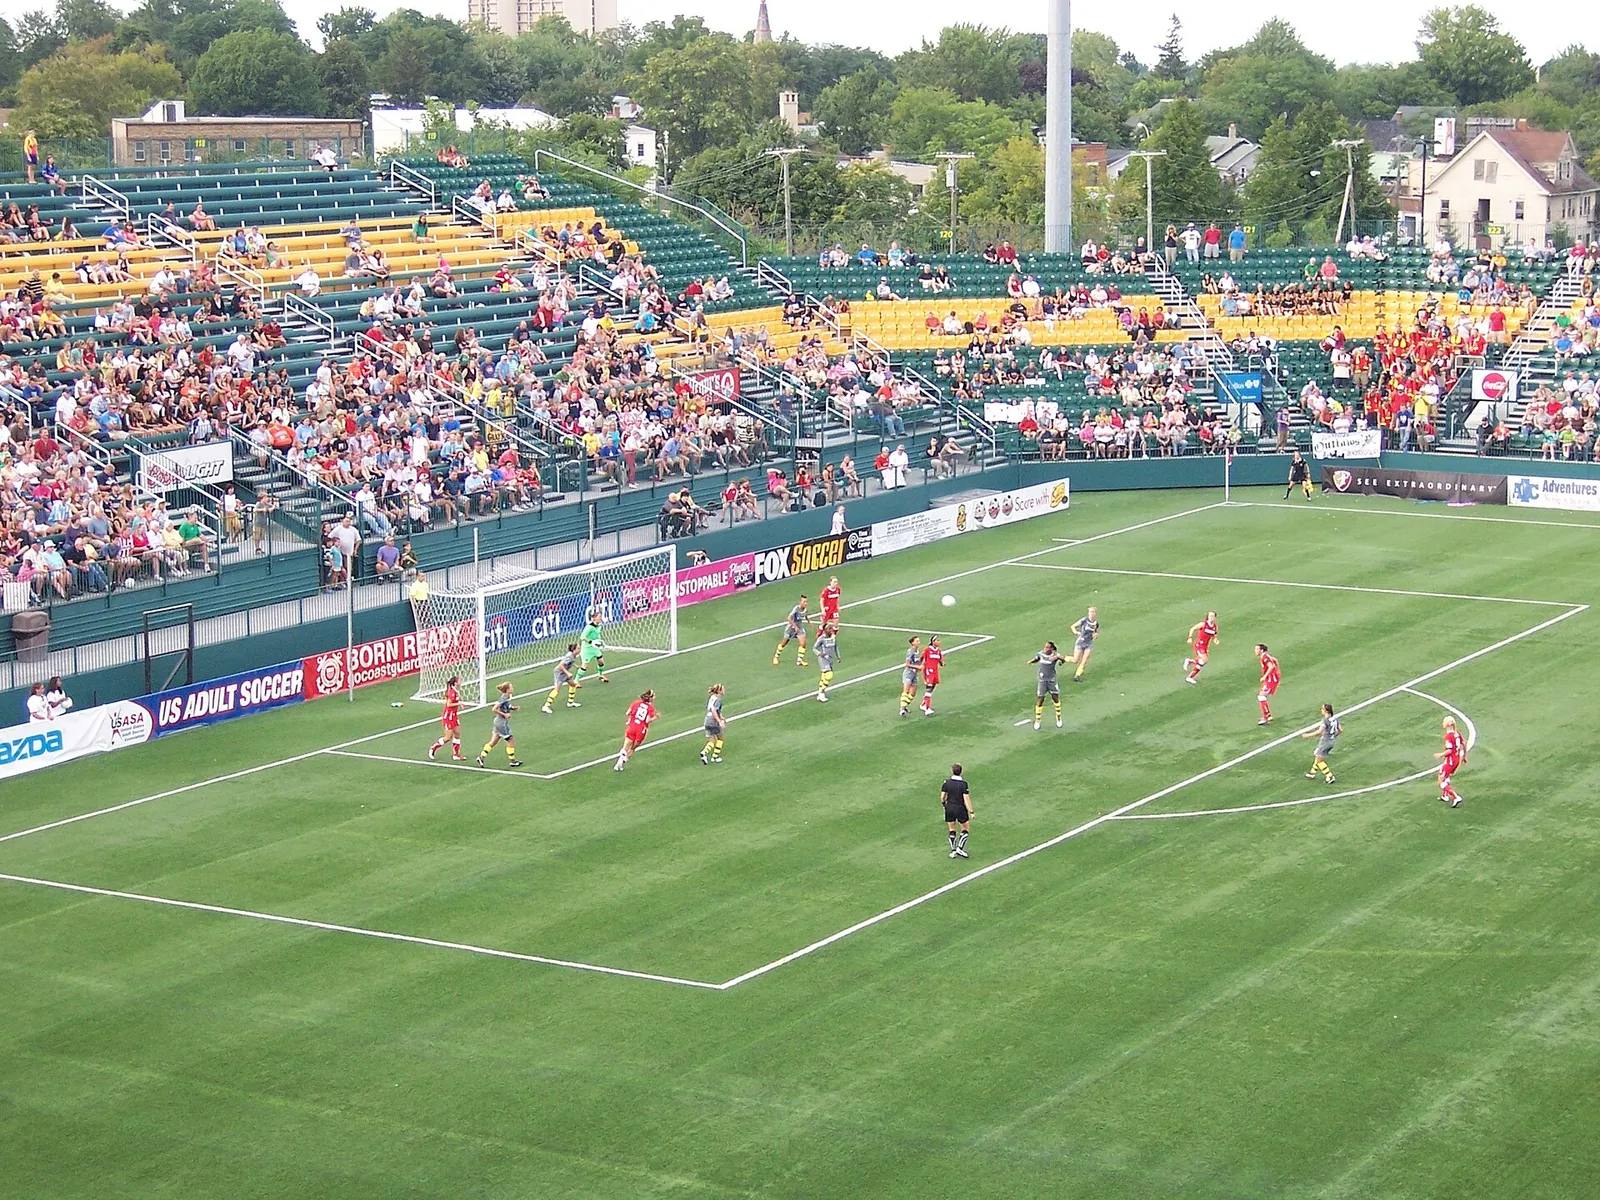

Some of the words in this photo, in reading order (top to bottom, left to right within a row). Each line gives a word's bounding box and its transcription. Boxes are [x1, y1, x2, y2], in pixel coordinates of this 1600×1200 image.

[939, 230, 954, 238] 120
[1242, 225, 1256, 234] 121
[183, 459, 225, 481] LIGHT
[1356, 477, 1379, 488] SEE
[1386, 478, 1493, 493] EXTRAORDINARY
[1014, 495, 1035, 512] Score
[1035, 487, 1050, 505] with
[1542, 479, 1598, 496] Adventures
[754, 546, 792, 585] FOX
[790, 538, 847, 577] Soccer
[652, 585, 664, 603] BE
[665, 570, 729, 600] UNSTOPPABLE
[483, 621, 508, 653] citi
[532, 608, 560, 639] citi
[346, 638, 400, 673] BORN
[403, 624, 462, 659] READY
[346, 651, 446, 688] gocoastguard.com
[159, 696, 182, 727] US
[182, 683, 238, 721] ADULT
[239, 669, 304, 707] SOCCER
